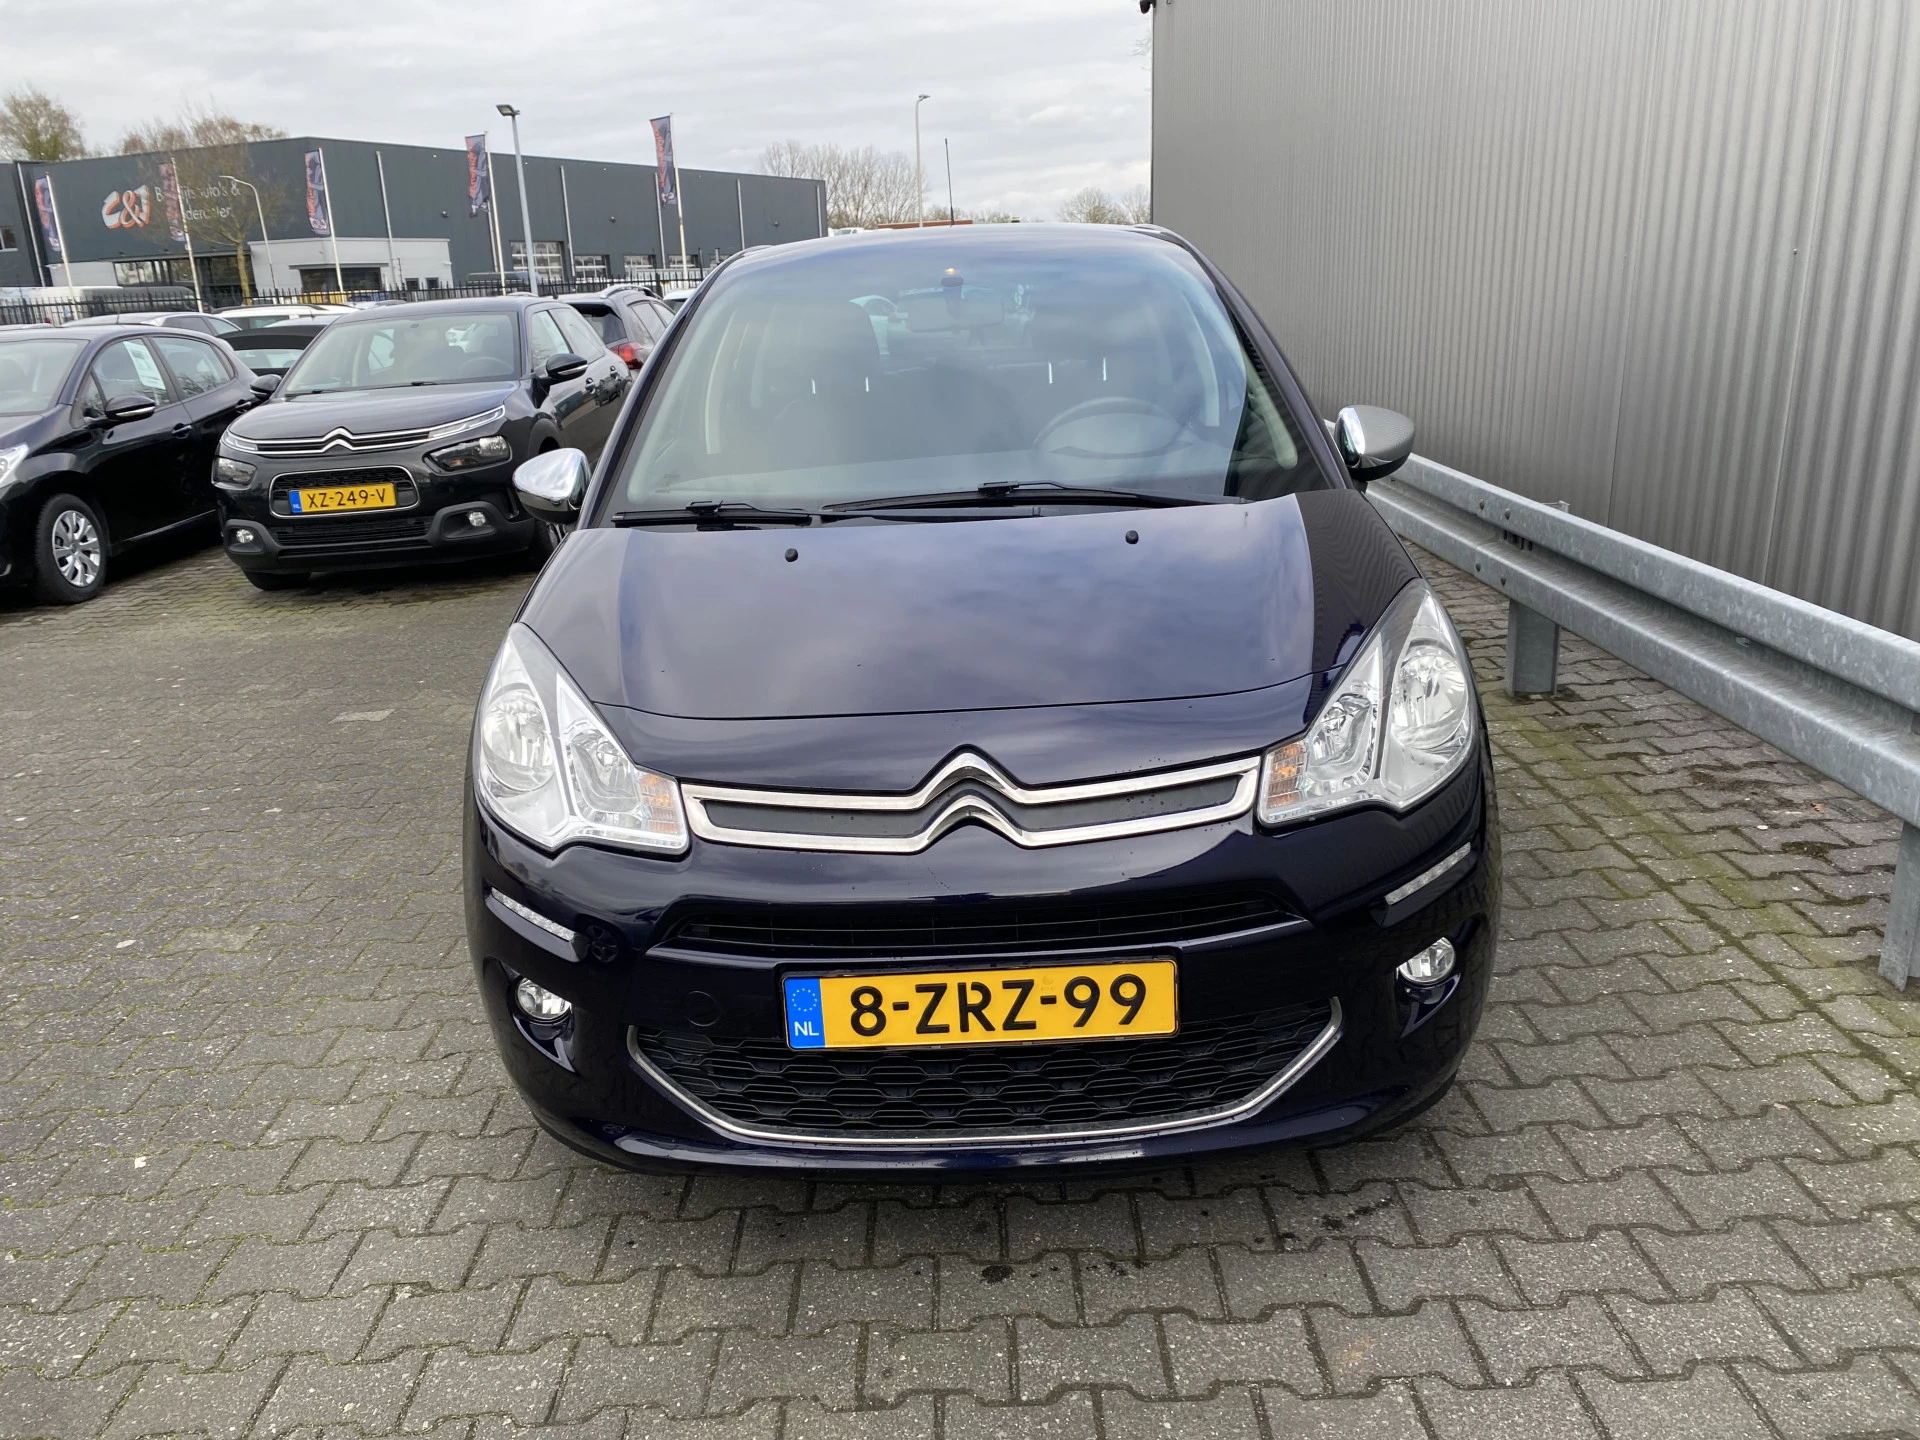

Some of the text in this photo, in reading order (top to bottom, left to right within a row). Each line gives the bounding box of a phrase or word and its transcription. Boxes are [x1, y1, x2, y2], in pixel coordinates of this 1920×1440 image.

[307, 488, 386, 509] XZ-249-V
[850, 974, 1146, 1037] 8-ZRZ-99
[794, 1021, 820, 1036] NL
